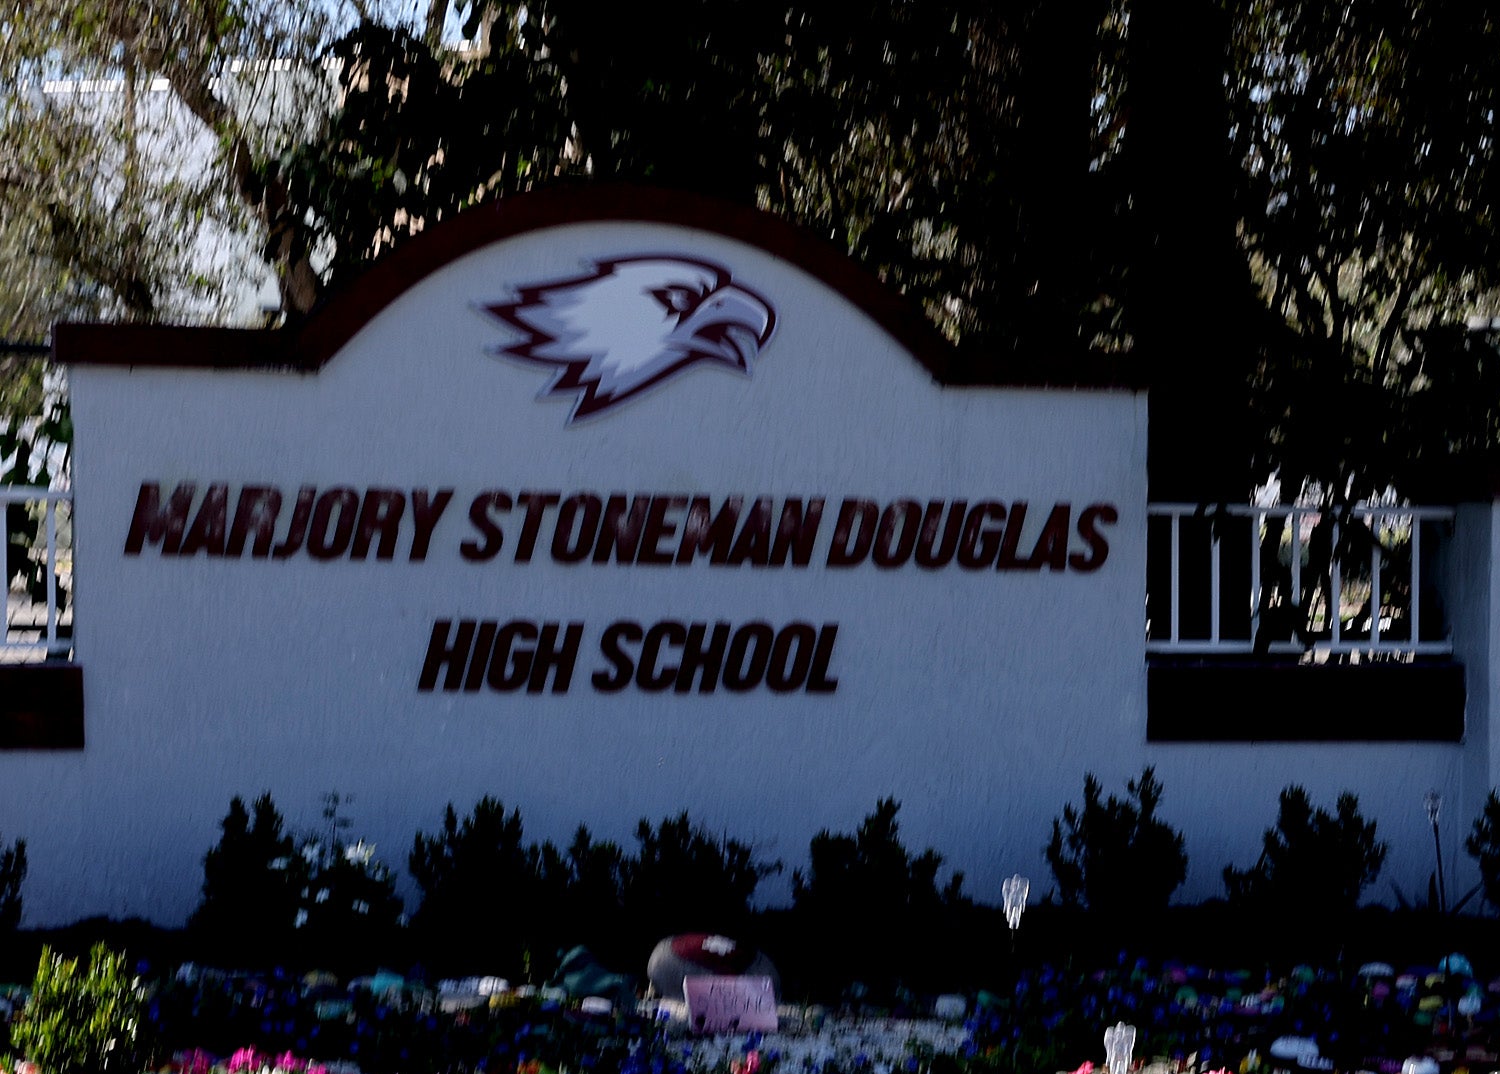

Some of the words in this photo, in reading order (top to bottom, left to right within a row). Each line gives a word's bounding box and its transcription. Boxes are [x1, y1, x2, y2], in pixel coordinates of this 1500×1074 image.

[124, 481, 453, 562] MARJORY
[459, 487, 825, 568] STONEMAN
[826, 496, 1118, 573] DOUGLAS
[417, 619, 584, 693] HIGH
[592, 619, 839, 694] SCHOOL
